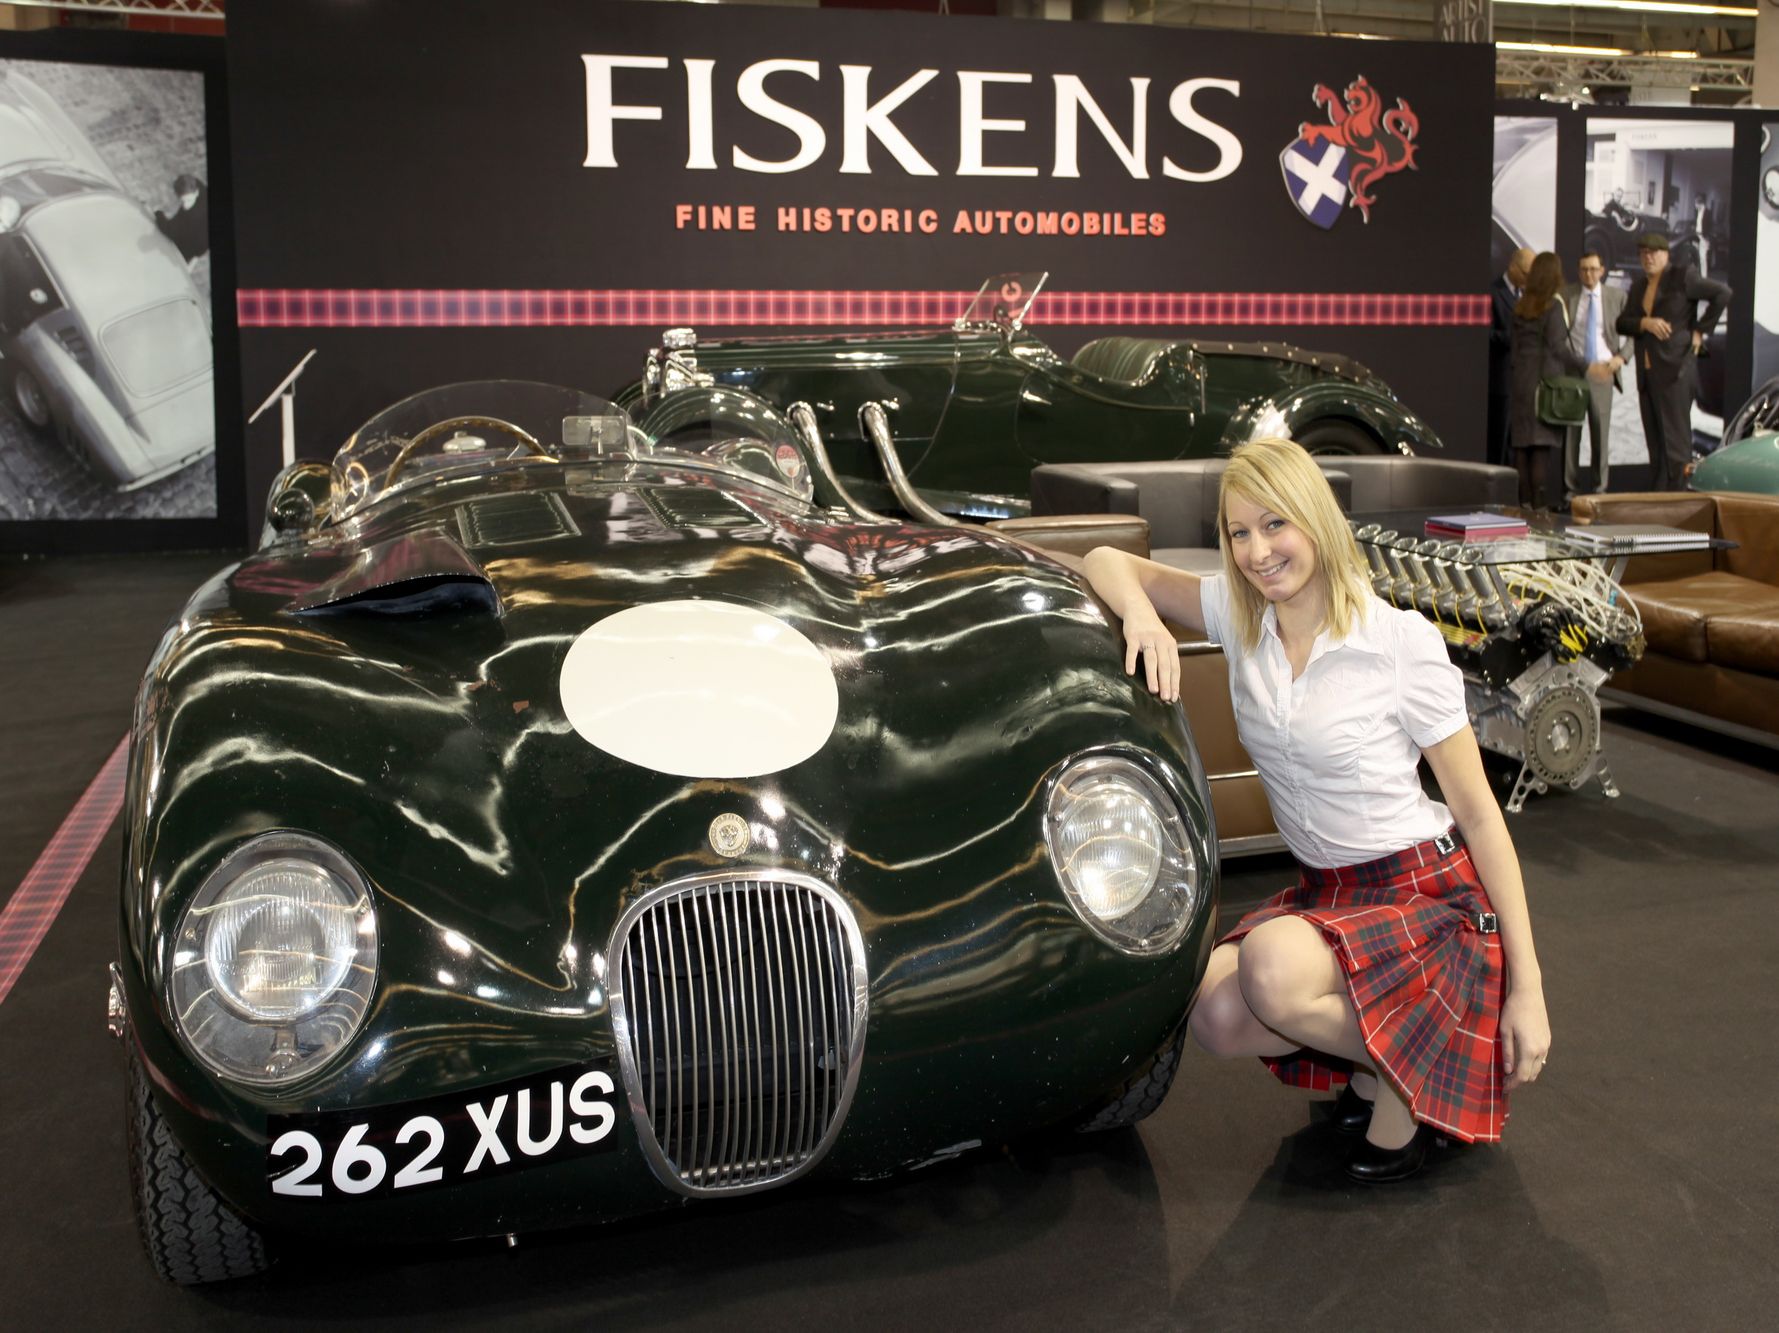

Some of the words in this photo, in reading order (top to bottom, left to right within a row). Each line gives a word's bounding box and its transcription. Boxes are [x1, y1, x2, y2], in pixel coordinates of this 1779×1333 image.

[580, 53, 1243, 183] FISKENS
[675, 204, 757, 231] FINE
[777, 206, 939, 234] HISTORIC
[952, 209, 1167, 237] AUTOMOBILES
[270, 1115, 446, 1197] 262
[463, 1070, 616, 1174] XUS
